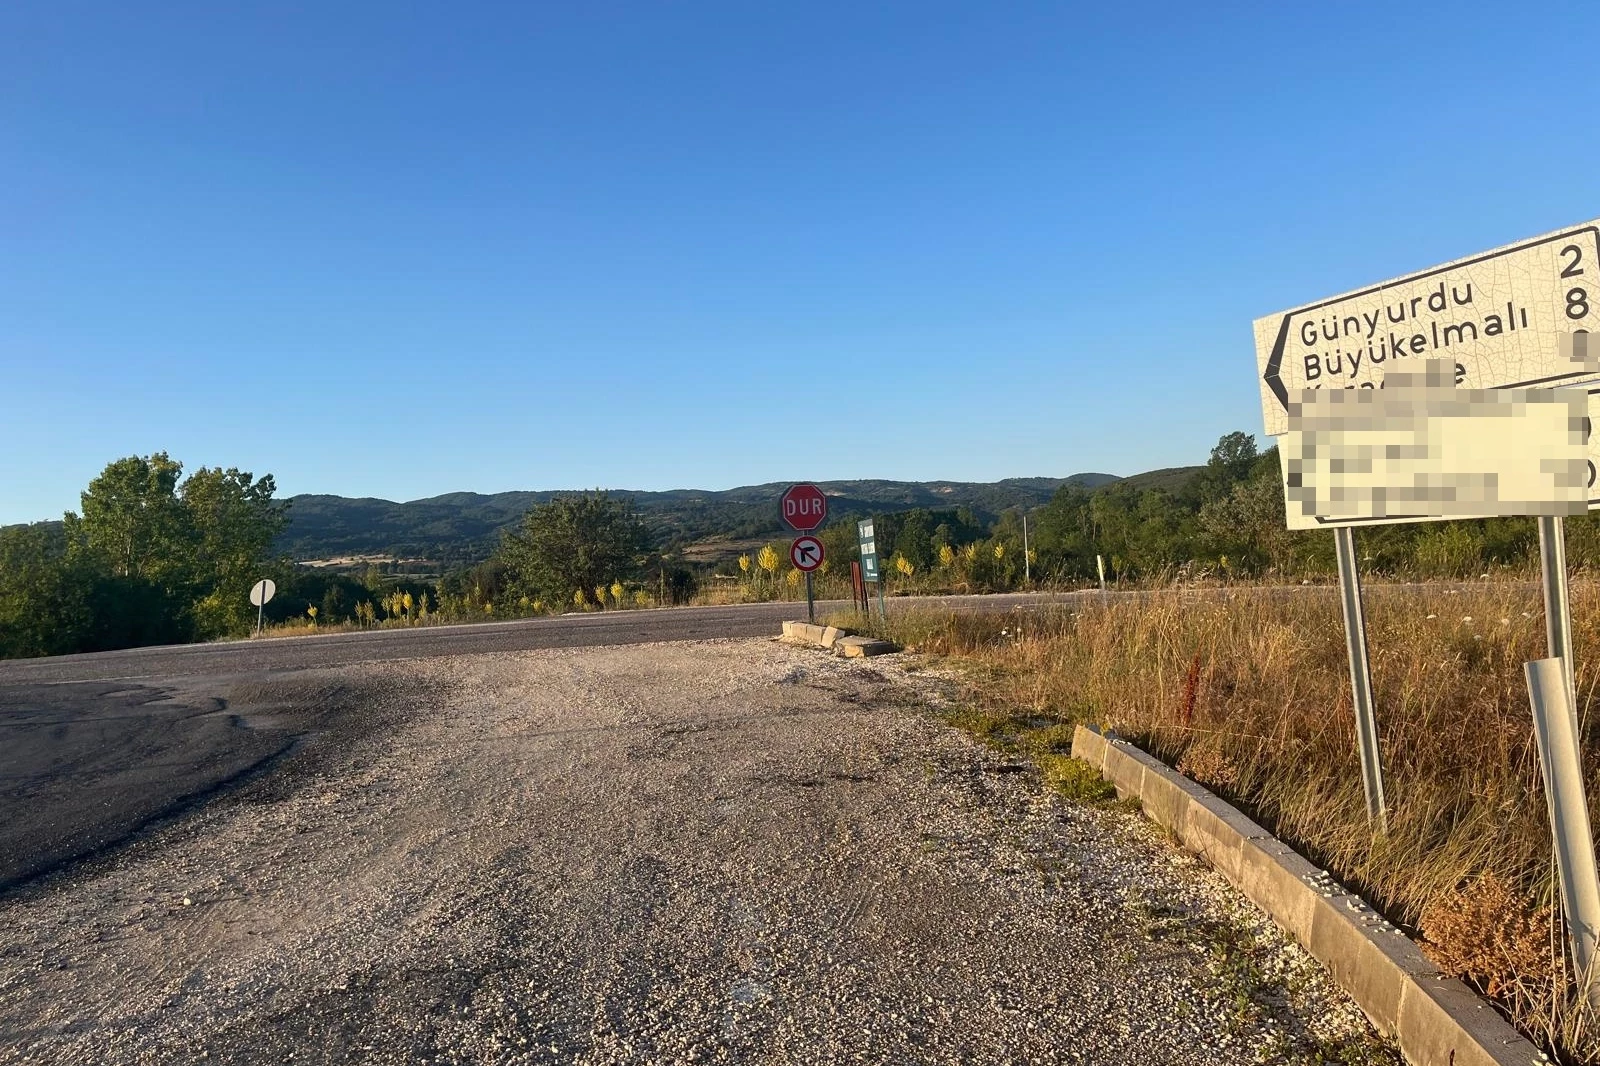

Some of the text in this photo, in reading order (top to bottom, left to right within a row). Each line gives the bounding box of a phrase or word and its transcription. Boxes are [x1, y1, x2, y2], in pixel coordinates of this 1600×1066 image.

[1301, 244, 1584, 346] Günyurdu 2
[1303, 301, 1528, 381] Büyükelmalı
[1565, 287, 1590, 320] 8
[786, 498, 822, 516] DUR
